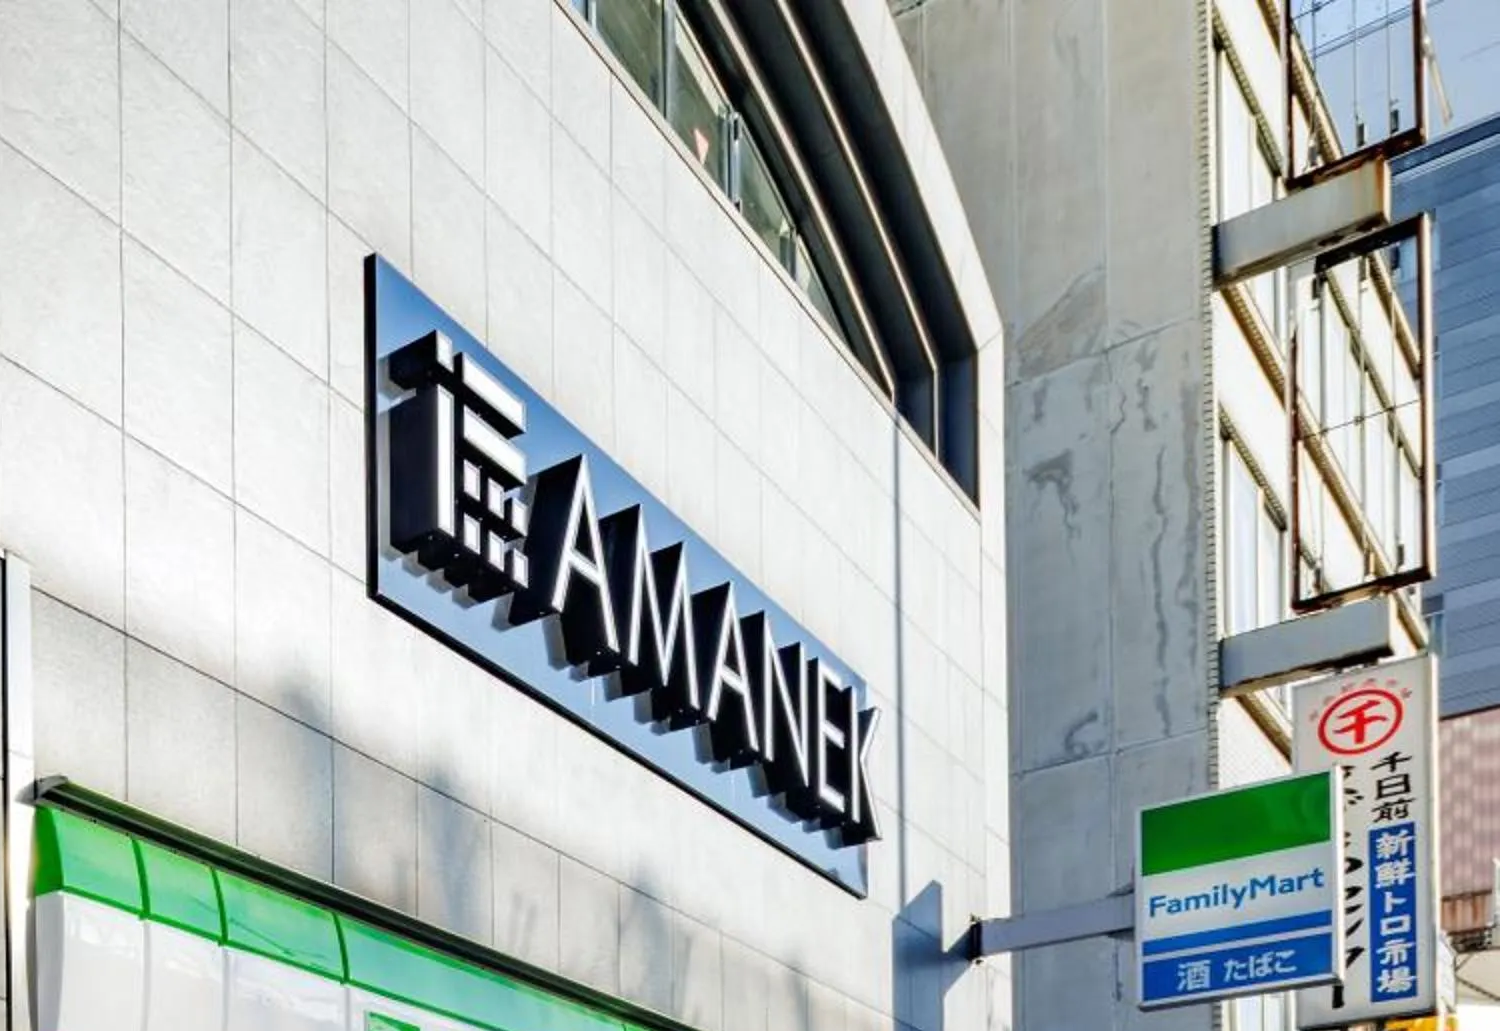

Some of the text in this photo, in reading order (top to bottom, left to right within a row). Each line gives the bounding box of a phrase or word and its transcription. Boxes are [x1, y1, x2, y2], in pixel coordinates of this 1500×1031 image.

[512, 453, 882, 843] AMANEK
[1149, 867, 1325, 919] FamilyMart
[1176, 948, 1298, 992] 酒 たばこ
